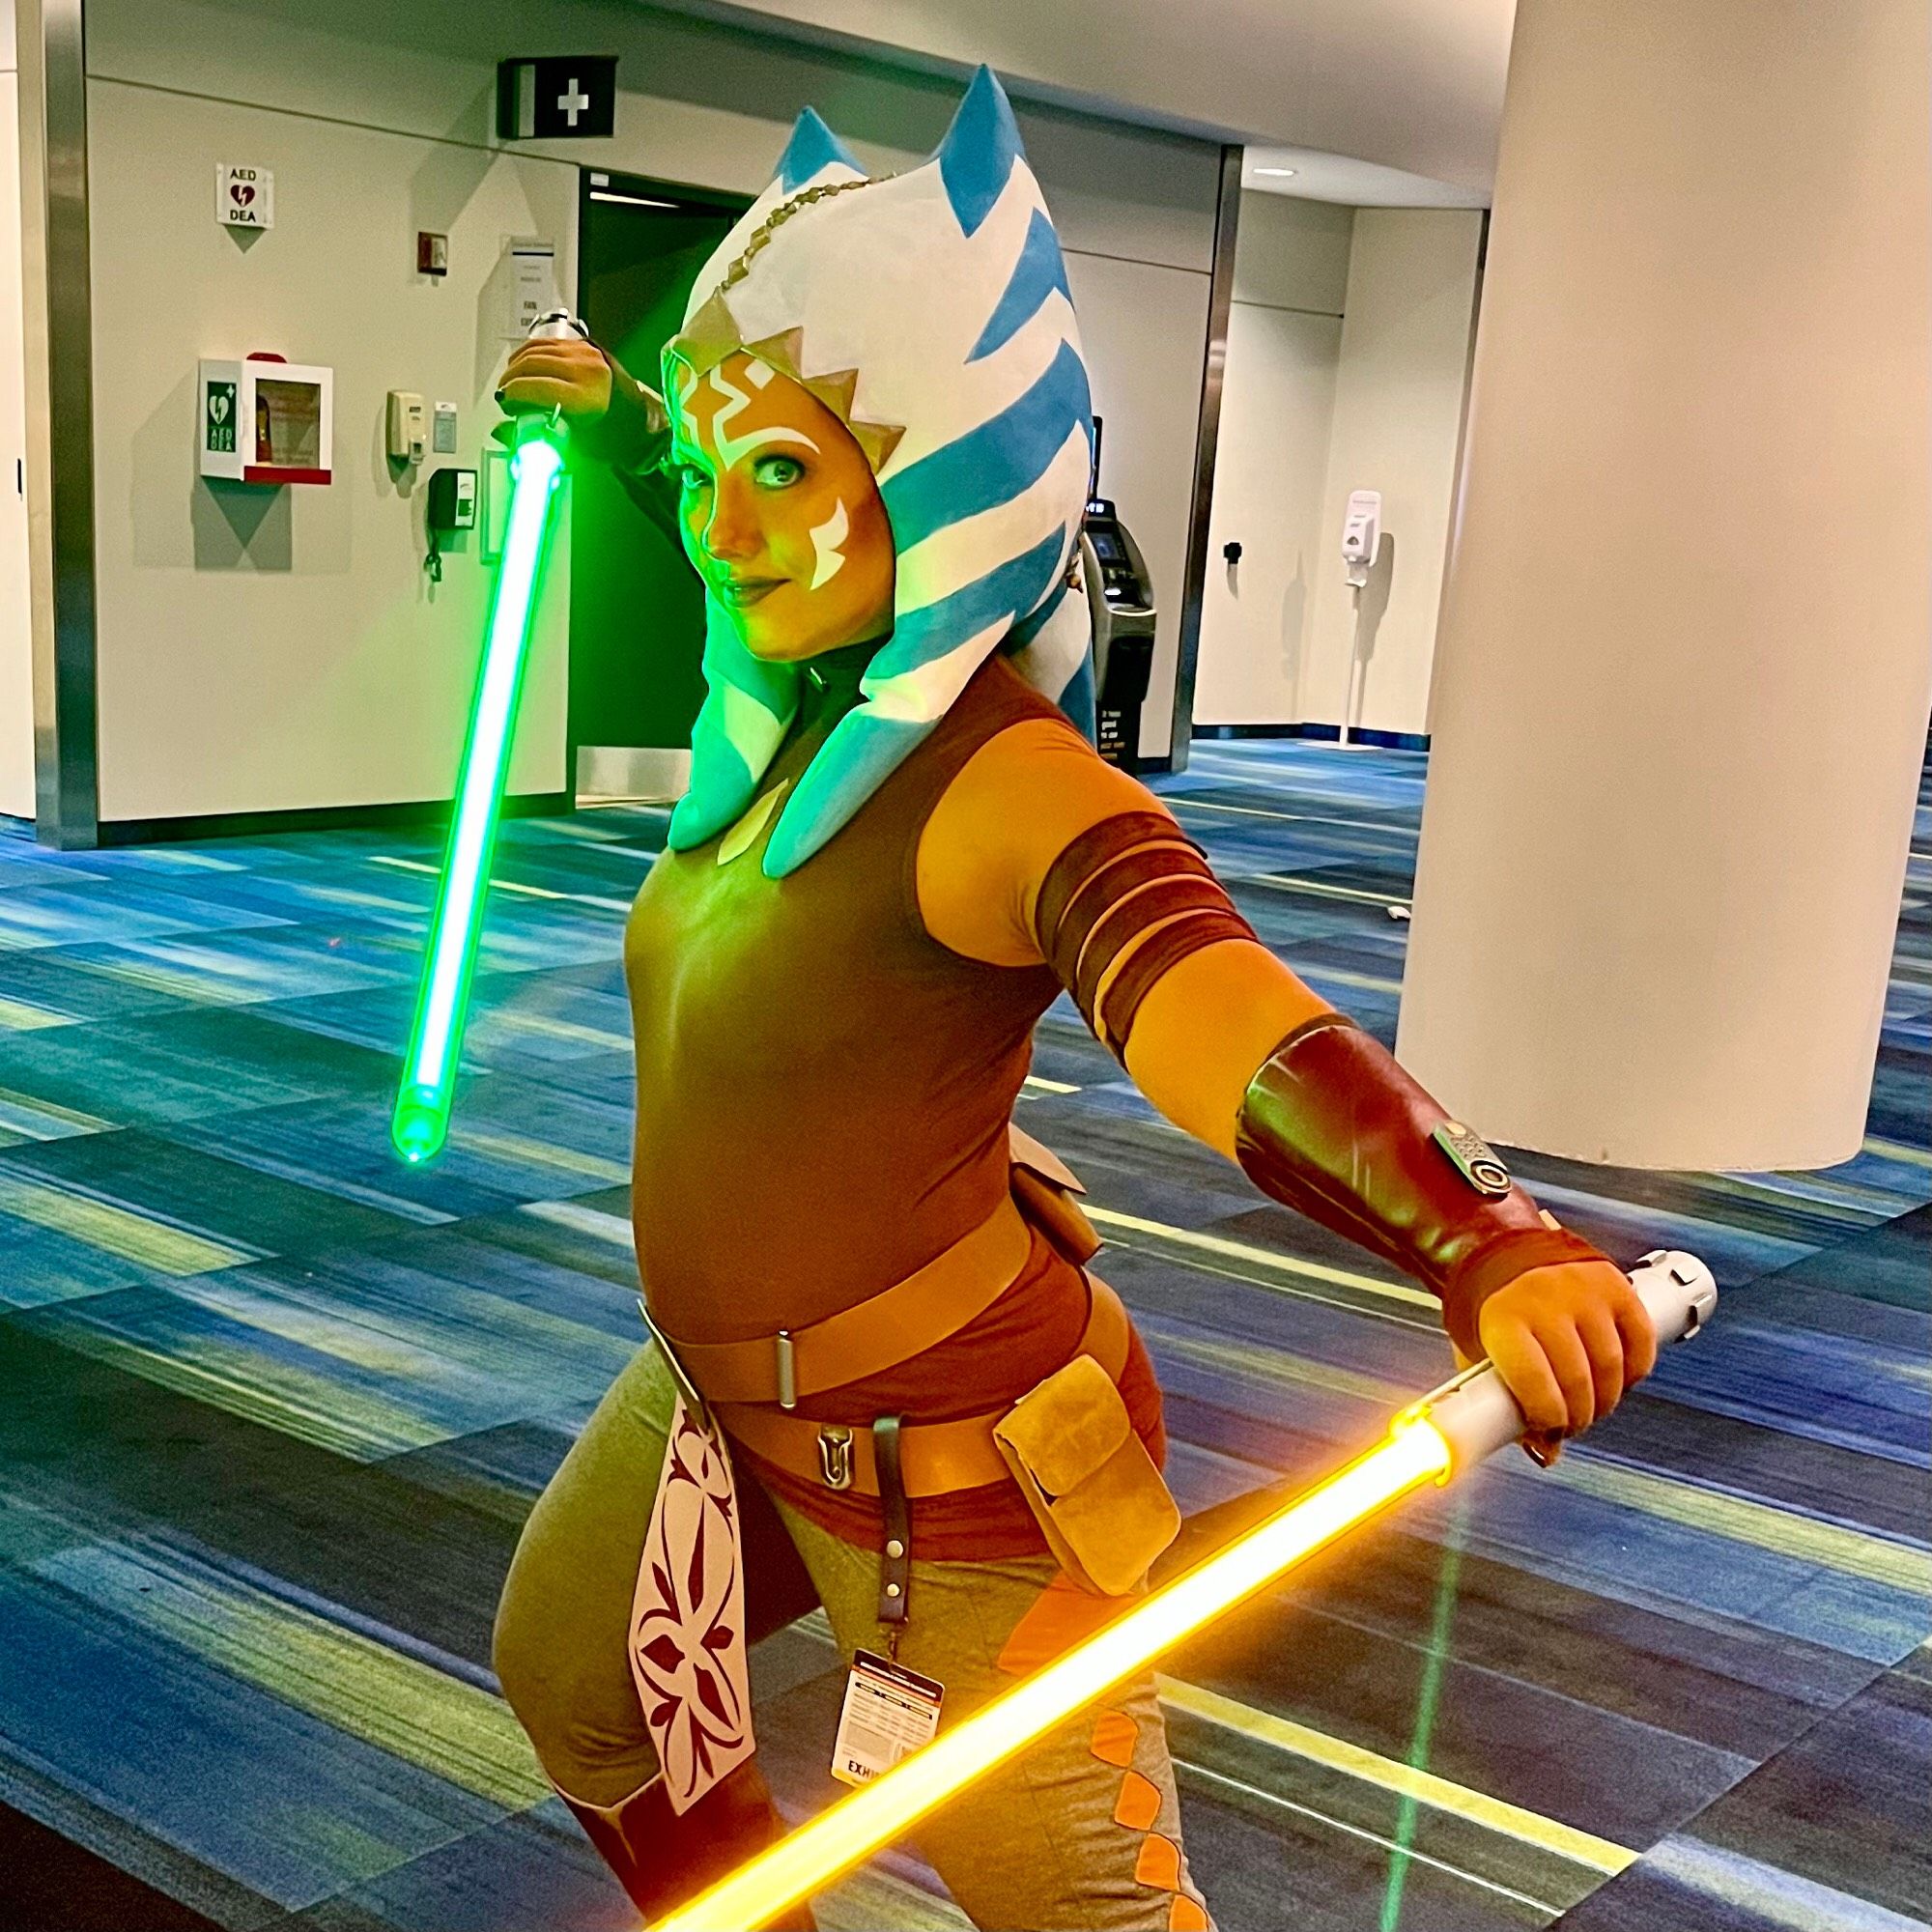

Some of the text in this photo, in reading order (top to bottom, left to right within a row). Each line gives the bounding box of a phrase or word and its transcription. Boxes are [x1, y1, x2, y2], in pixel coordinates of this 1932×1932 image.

[229, 168, 257, 182] AED
[229, 209, 257, 223] DEA
[211, 427, 233, 442] AED
